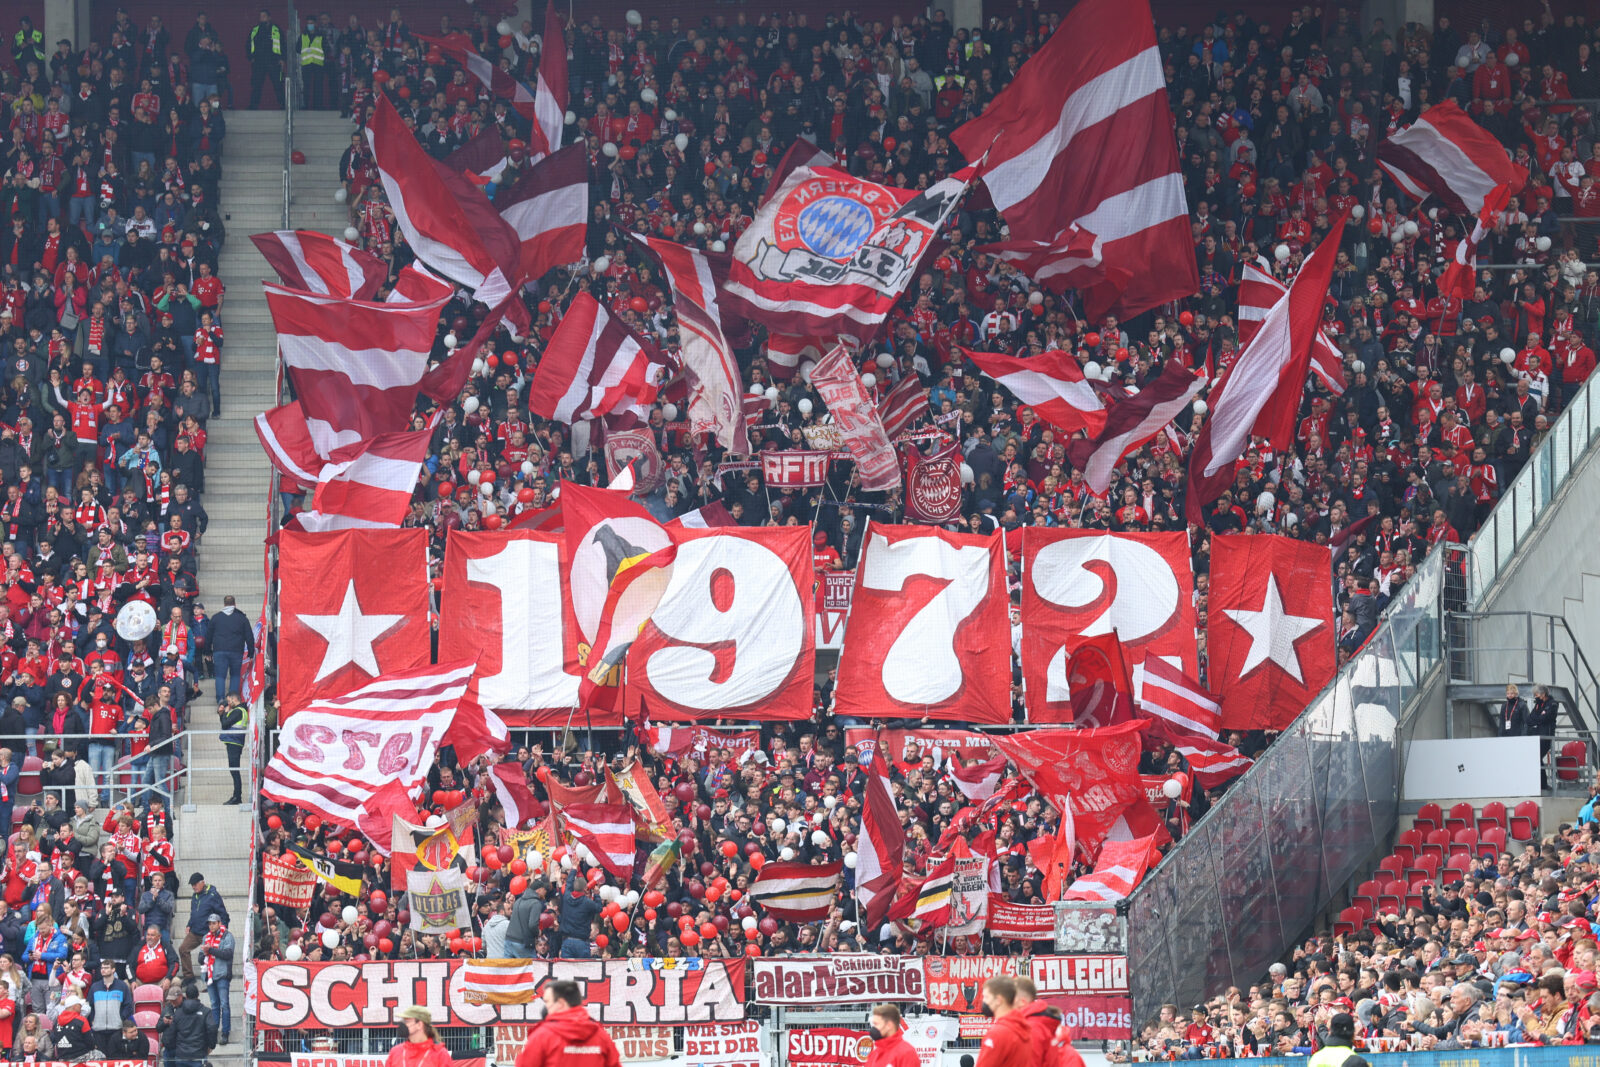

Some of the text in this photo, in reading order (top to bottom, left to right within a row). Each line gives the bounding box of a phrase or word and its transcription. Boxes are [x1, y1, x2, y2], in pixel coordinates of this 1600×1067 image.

[763, 455, 828, 483] RFM
[904, 735, 961, 749] Bayern
[264, 878, 315, 899] MÜNCHEN
[415, 892, 458, 913] ULTRAS
[833, 957, 882, 972] Sektion
[1031, 957, 1127, 991] COLEGIO
[929, 982, 959, 1006] RED
[721, 1019, 760, 1036] SIND
[623, 1039, 670, 1059] UNS
[686, 1037, 760, 1056] BEI DIR
